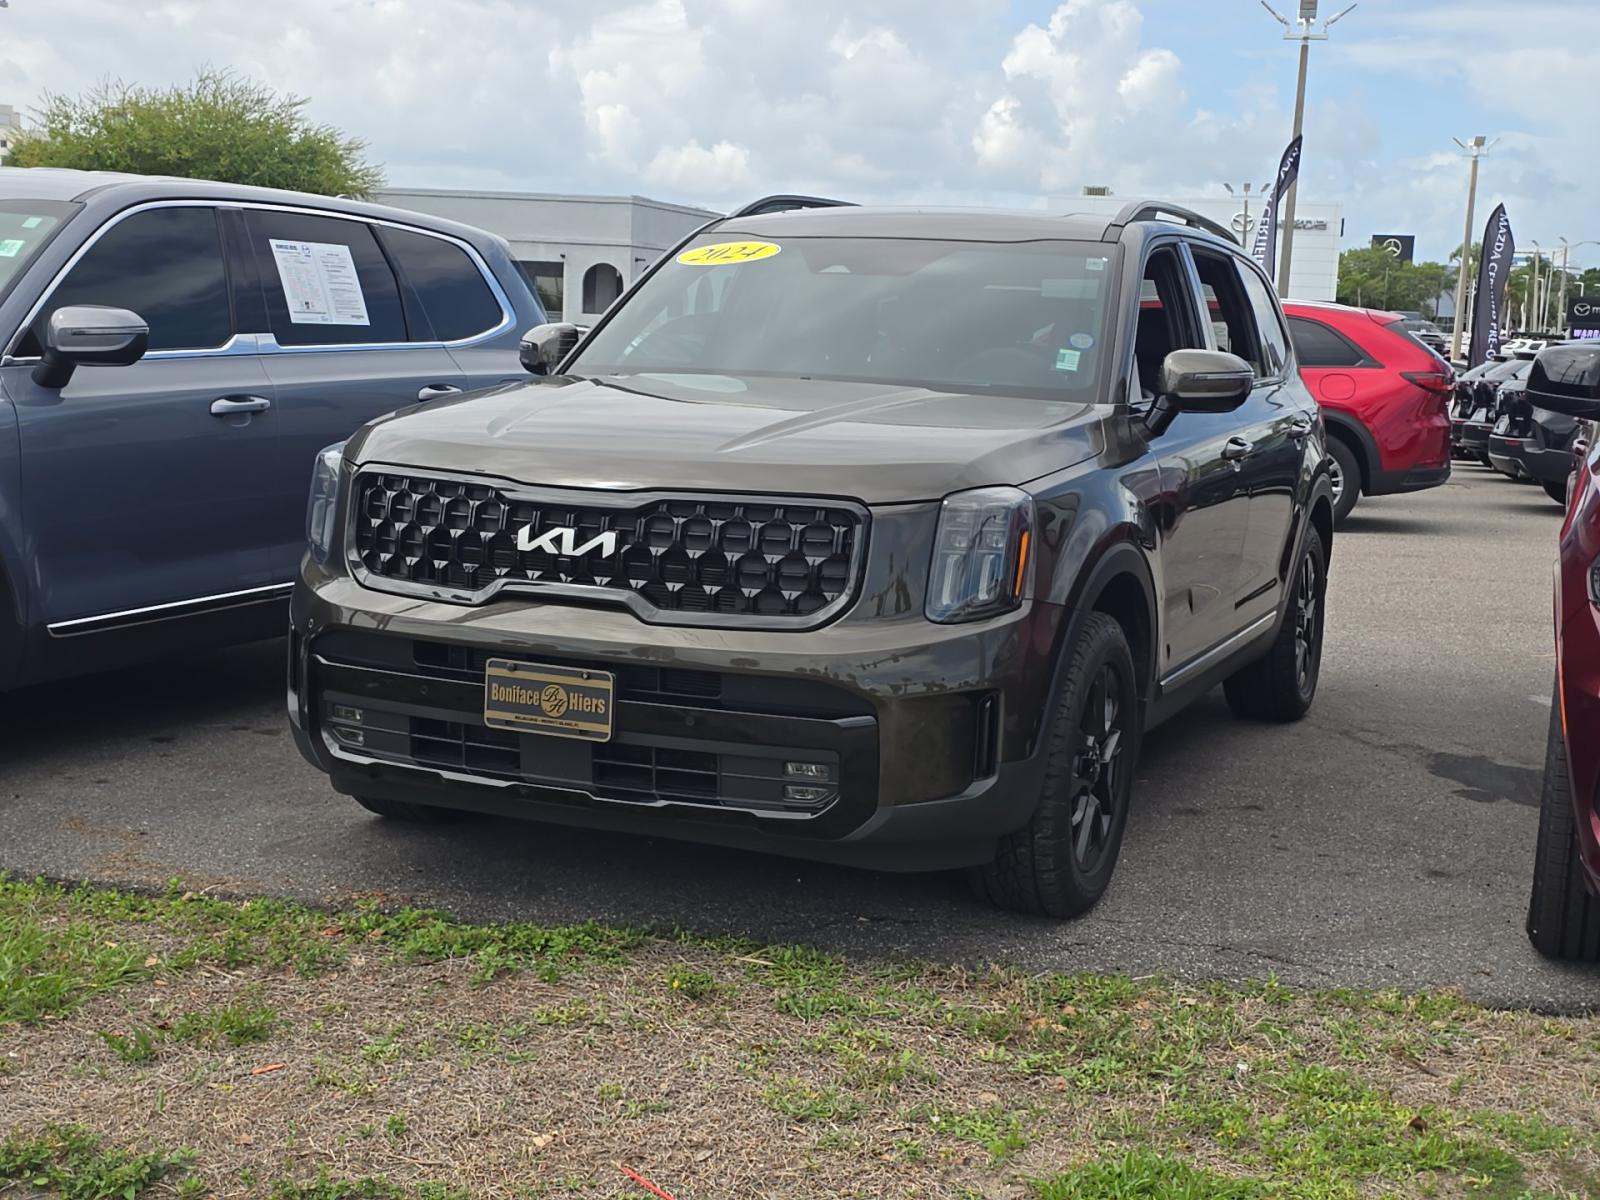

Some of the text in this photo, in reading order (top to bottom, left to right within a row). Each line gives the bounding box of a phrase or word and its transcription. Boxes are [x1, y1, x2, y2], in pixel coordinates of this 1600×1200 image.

[1489, 212, 1509, 260] MAZDA
[687, 245, 769, 262] 2024
[517, 523, 616, 559] KIA
[491, 683, 540, 706] Boniface
[569, 692, 606, 714] Hiers
